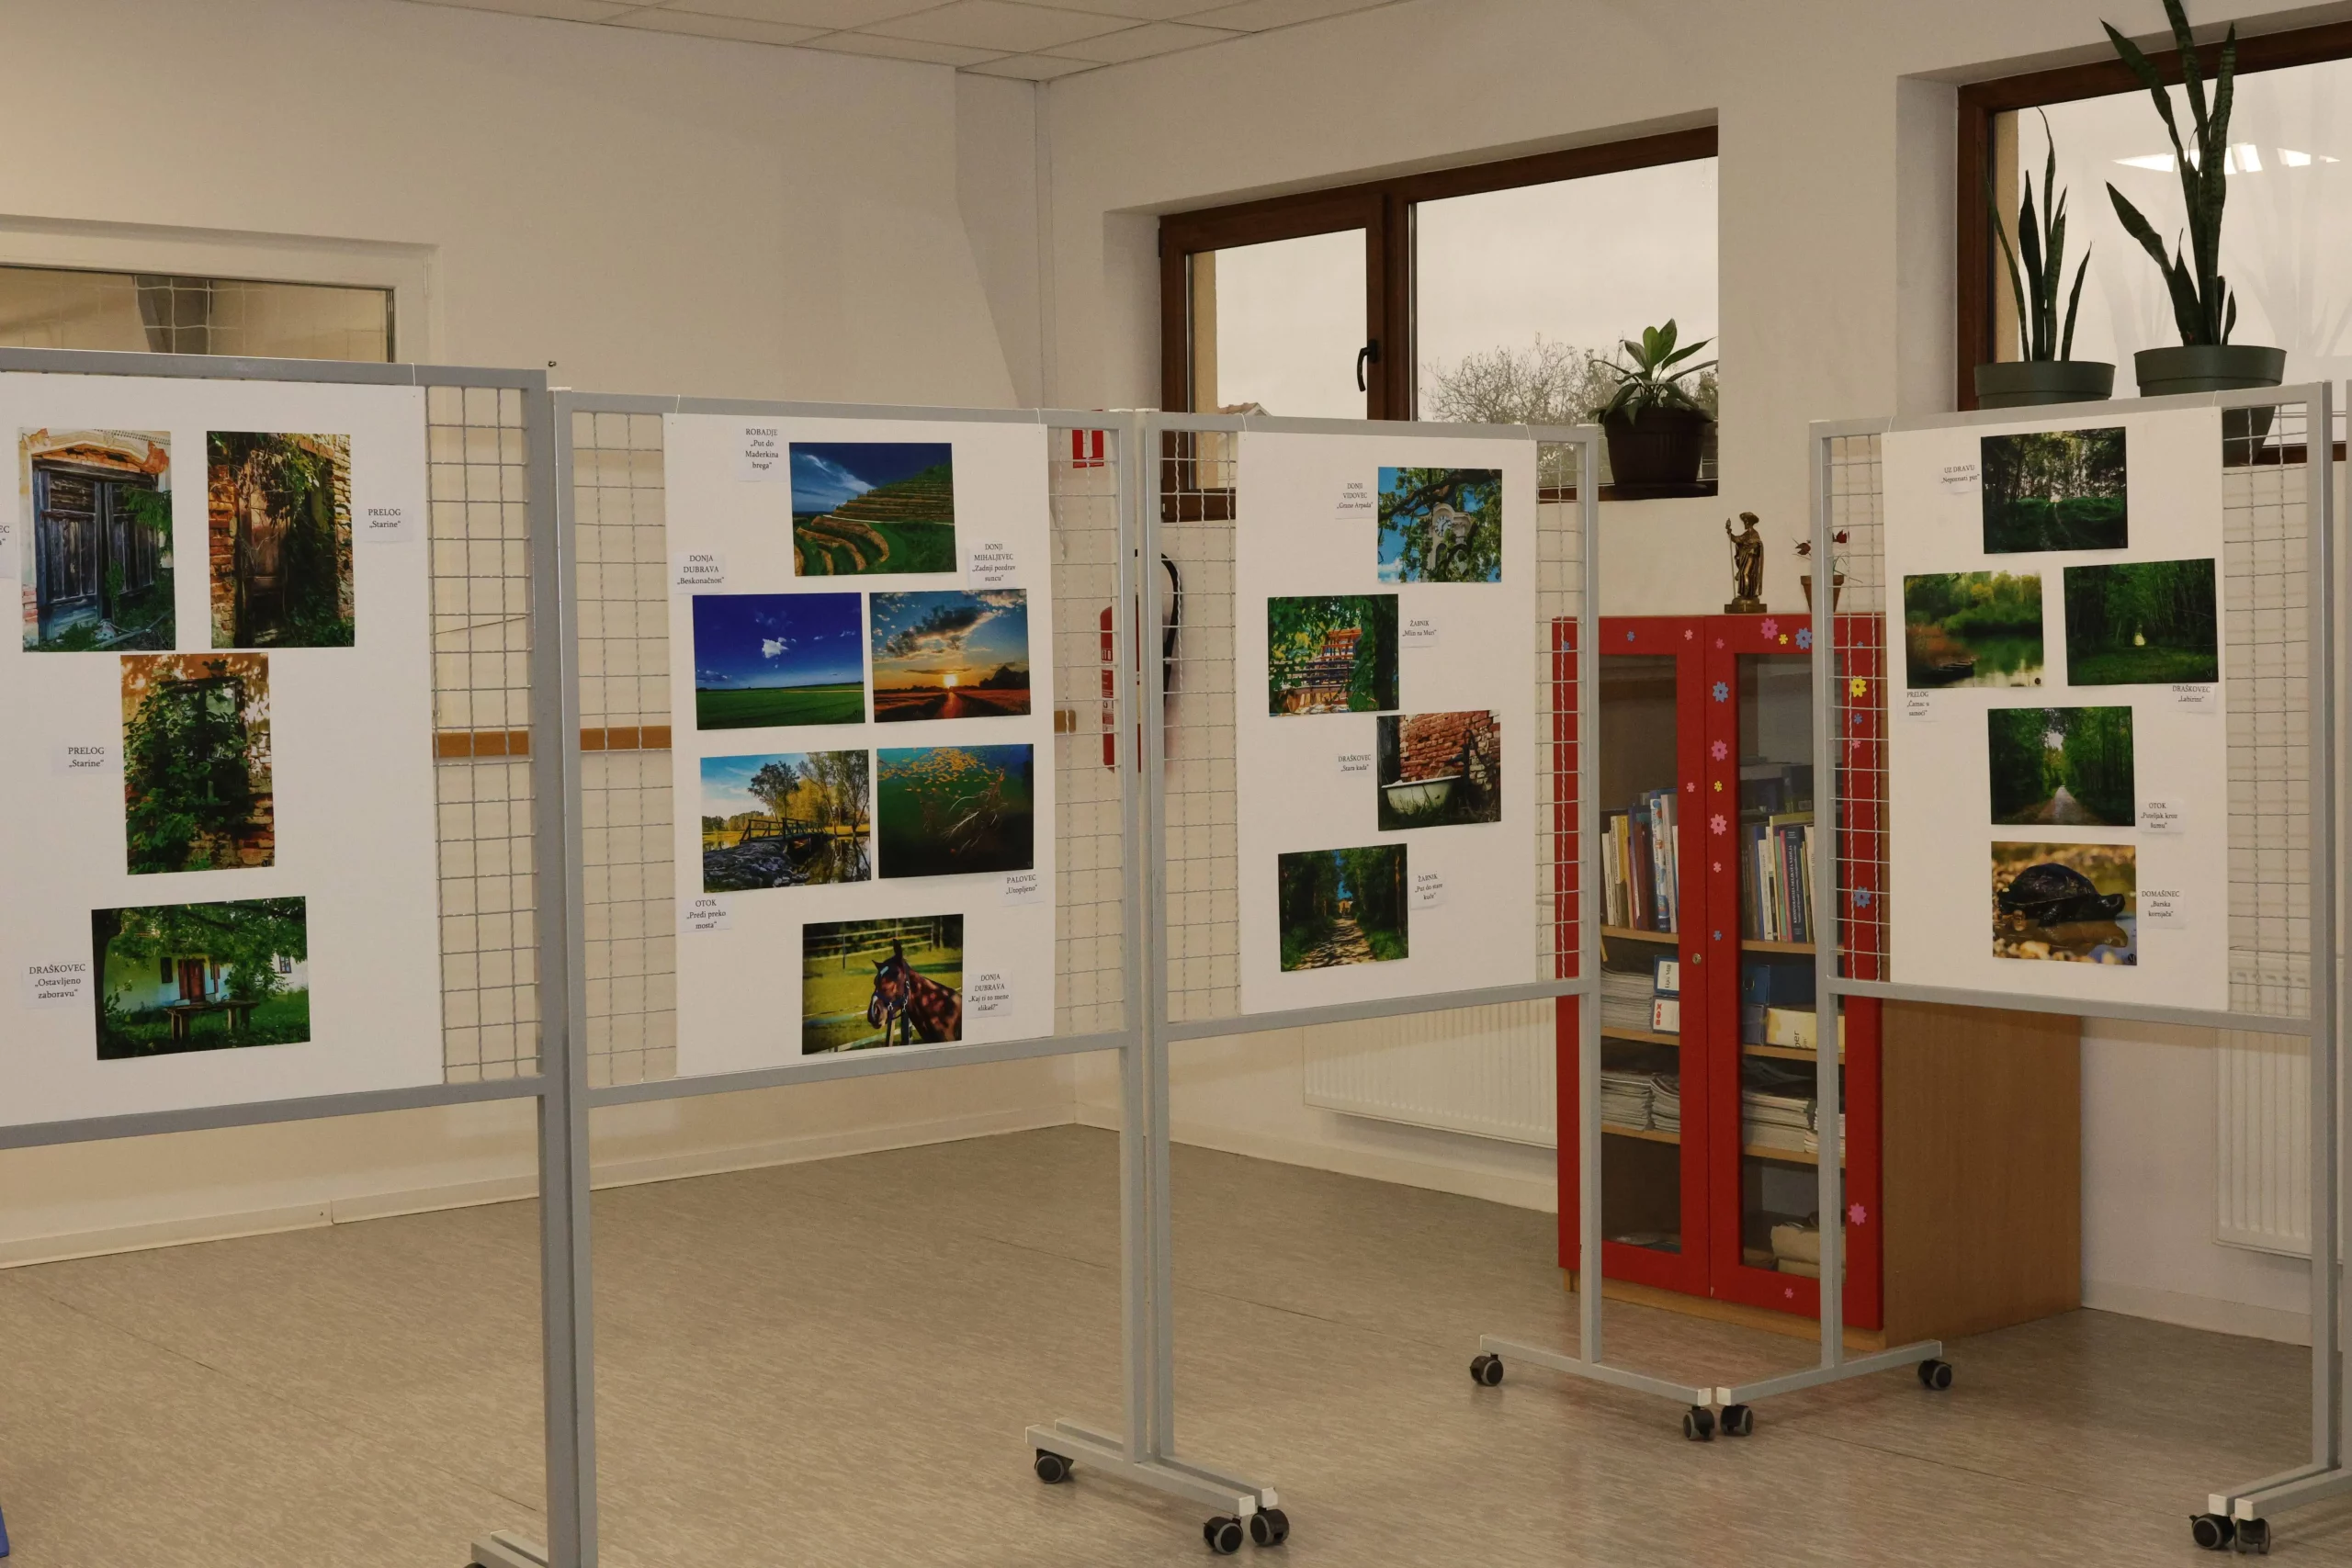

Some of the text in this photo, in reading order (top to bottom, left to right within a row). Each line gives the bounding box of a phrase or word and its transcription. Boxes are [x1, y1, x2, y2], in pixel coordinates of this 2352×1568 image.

[368, 508, 401, 516] PRELOG
[974, 553, 1014, 562] MIHALJEVEC
[68, 746, 105, 755] PRELOG
[1006, 874, 1037, 884] PALOVEC
[695, 899, 718, 908] OTOK
[707, 909, 727, 919] preko
[29, 964, 86, 975] DRAŠKOVEC
[980, 973, 1001, 982] DONJA
[974, 983, 1005, 992] DUBRAVA
